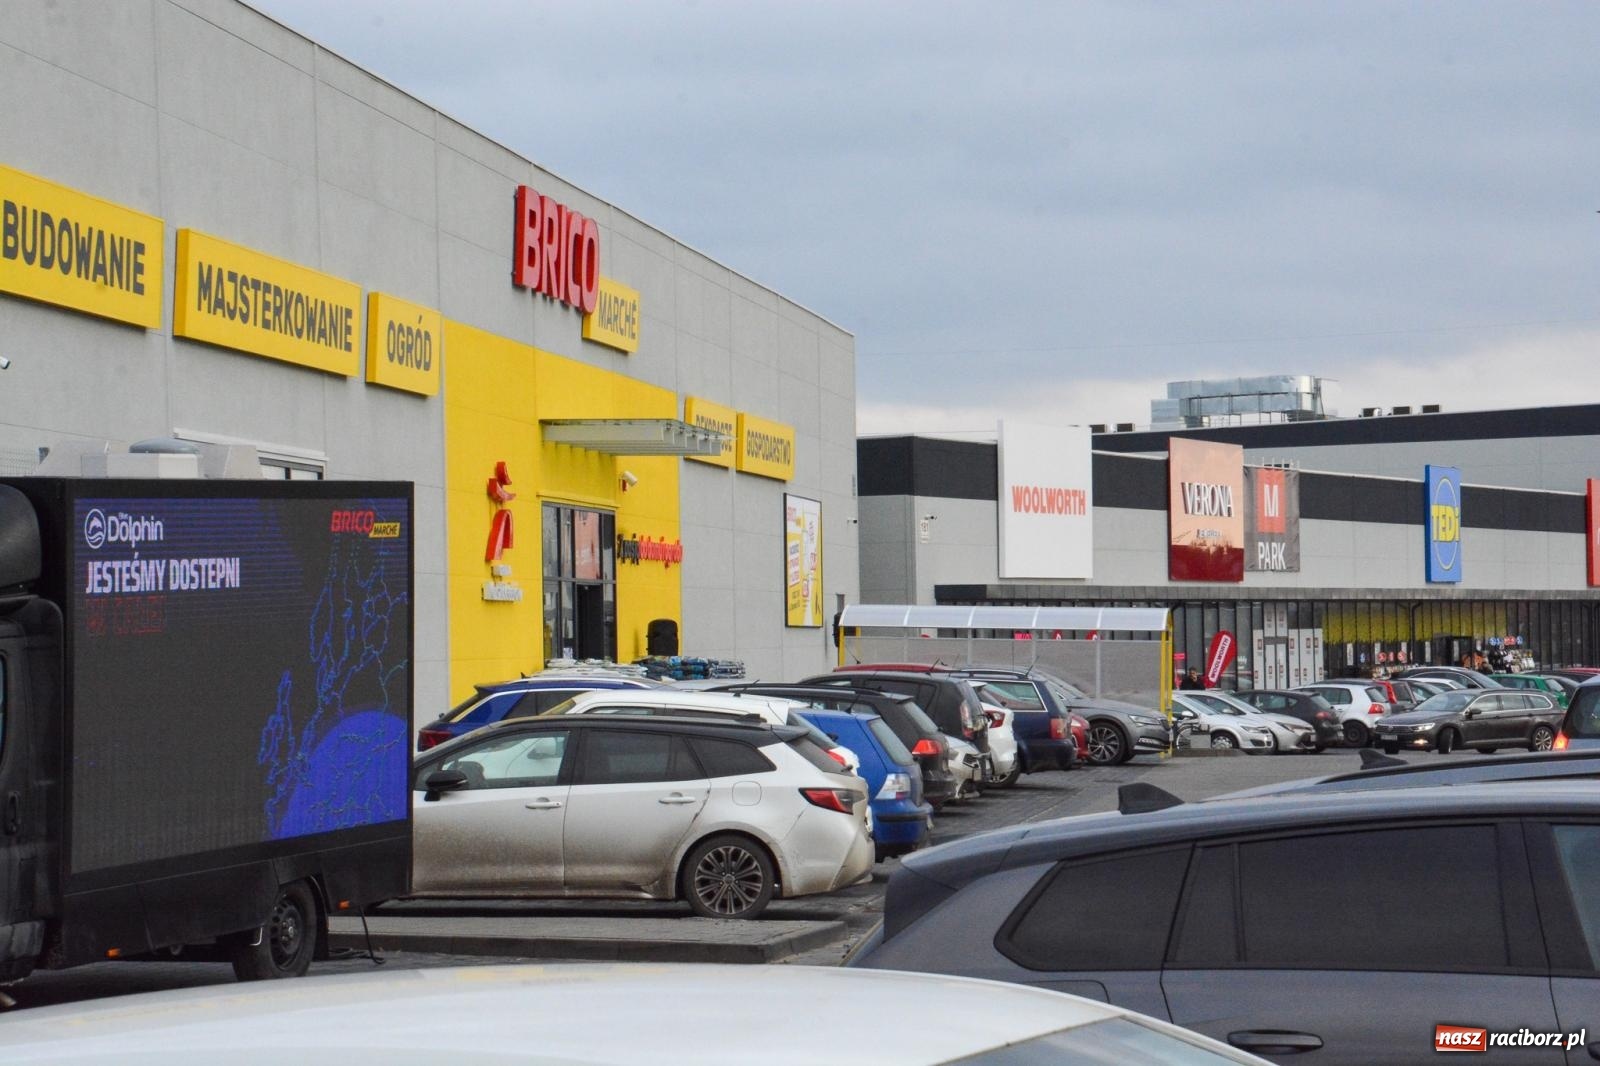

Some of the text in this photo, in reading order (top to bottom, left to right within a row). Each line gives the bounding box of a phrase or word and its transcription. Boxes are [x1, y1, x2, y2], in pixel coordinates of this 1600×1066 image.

[2, 199, 146, 296] BUDOWANIE
[514, 185, 600, 316] BRICO
[197, 261, 353, 353] MAJSTERKOWANIE
[387, 314, 433, 372] OGRÓD
[746, 429, 791, 466] GOSPODARSTWO
[1011, 486, 1086, 516] WOOLWORTH
[1181, 482, 1235, 518] VERONA
[1263, 484, 1280, 518] M
[107, 515, 164, 548] Dolphin
[331, 510, 375, 533] BRICO
[85, 552, 166, 594] JESTEŚMY
[1258, 541, 1287, 570] PARK
